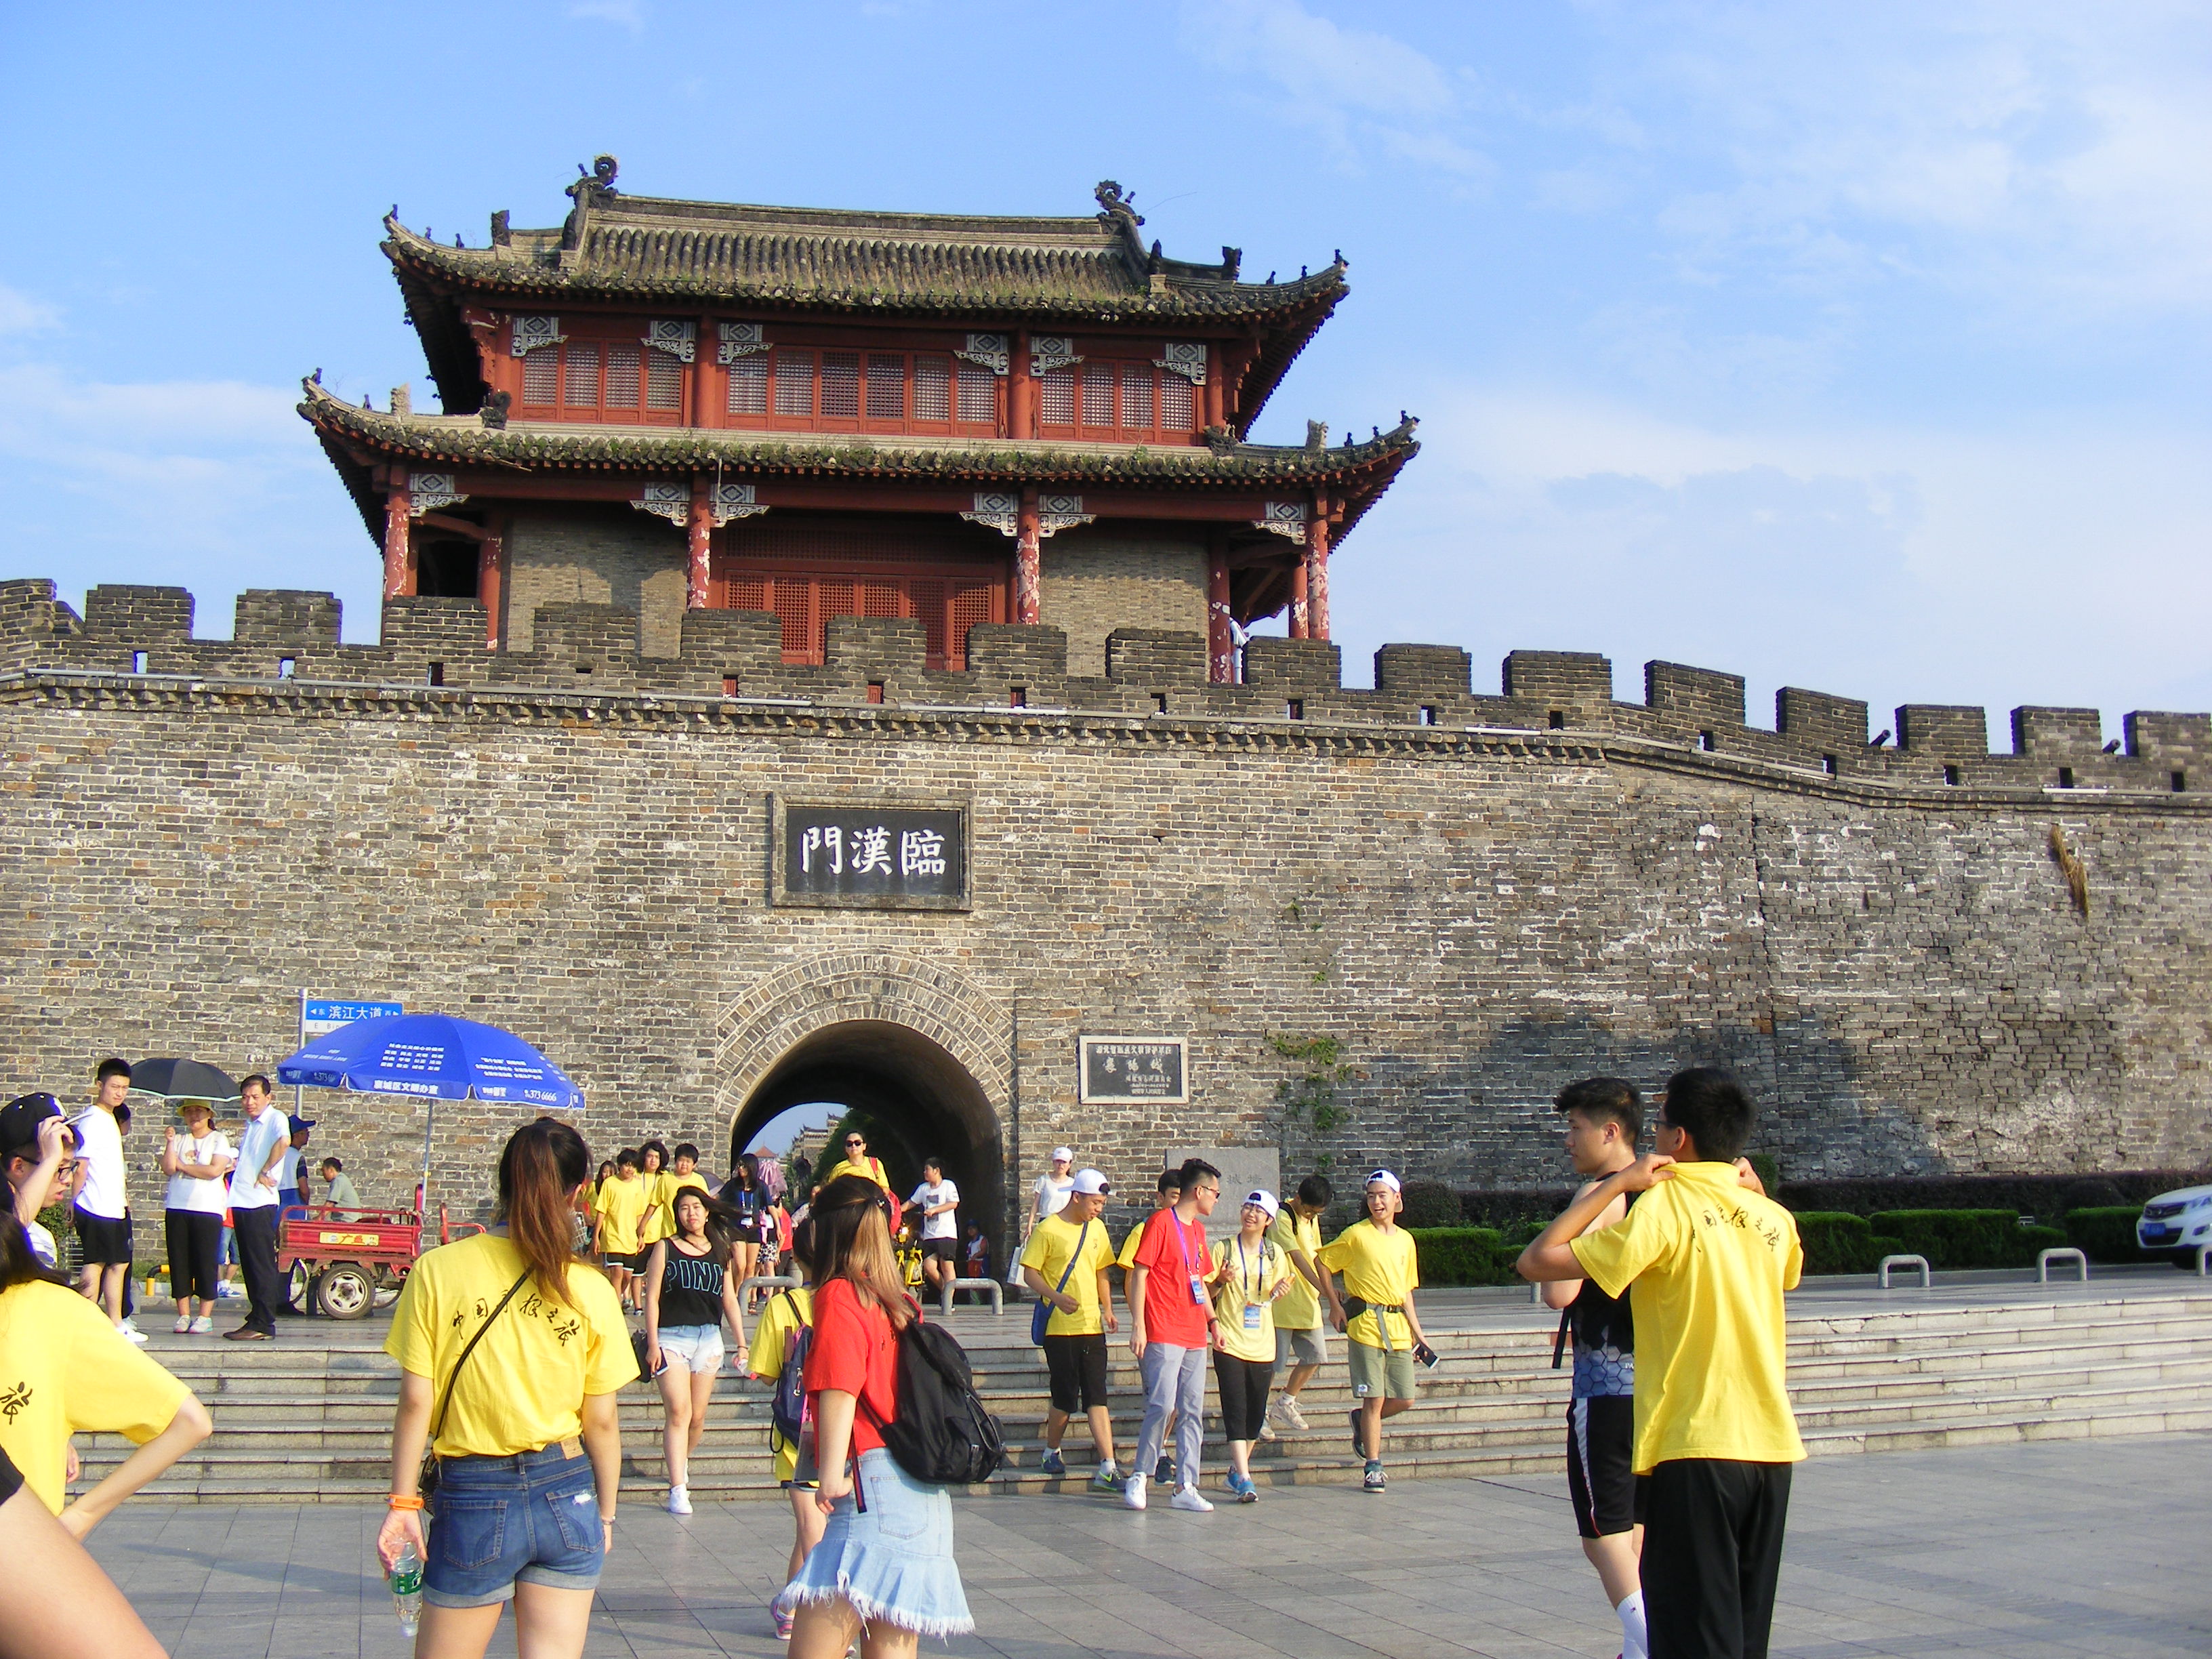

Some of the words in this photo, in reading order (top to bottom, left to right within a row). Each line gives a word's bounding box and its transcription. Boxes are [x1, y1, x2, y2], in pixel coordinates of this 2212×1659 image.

[328, 1005, 382, 1019] 滨江大道
[665, 1259, 724, 1297] PINK
